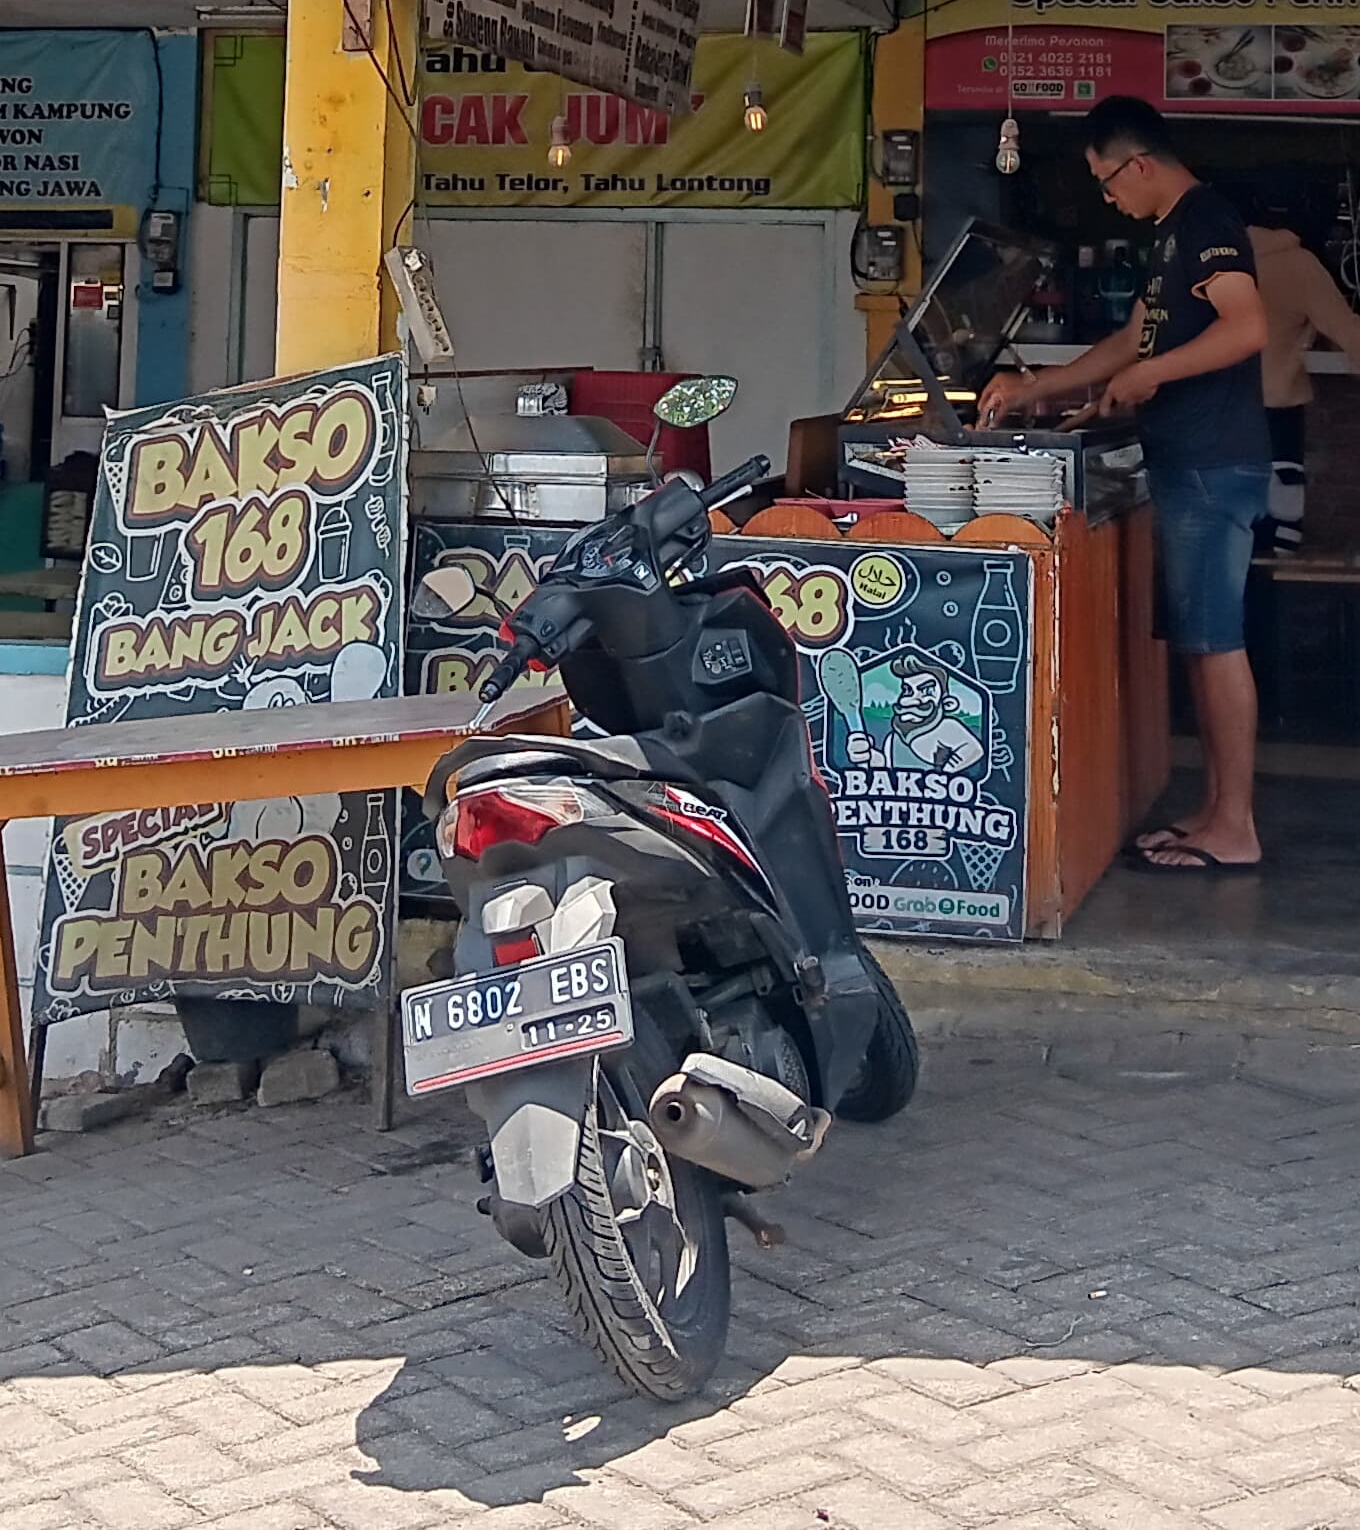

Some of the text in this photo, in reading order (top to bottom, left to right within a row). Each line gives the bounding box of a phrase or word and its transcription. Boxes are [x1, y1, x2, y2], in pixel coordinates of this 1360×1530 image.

[13, 102, 131, 121] KAMPUNG
[421, 94, 529, 146] CAK
[24, 153, 80, 172] NASI
[36, 179, 102, 198] JAWA
[423, 173, 771, 197] Tahu Telor, Tahu Lontong
[128, 389, 377, 520] BAKSO
[184, 493, 311, 597] 168
[97, 606, 243, 680] BANG
[243, 587, 381, 664] JACK
[844, 771, 974, 802] BAKSO
[881, 830, 929, 851] 168
[118, 838, 337, 919] BAKSO
[957, 900, 1000, 917] Food
[50, 906, 384, 983] PENTHUNG
[413, 959, 611, 1042] N 6802 EBS
